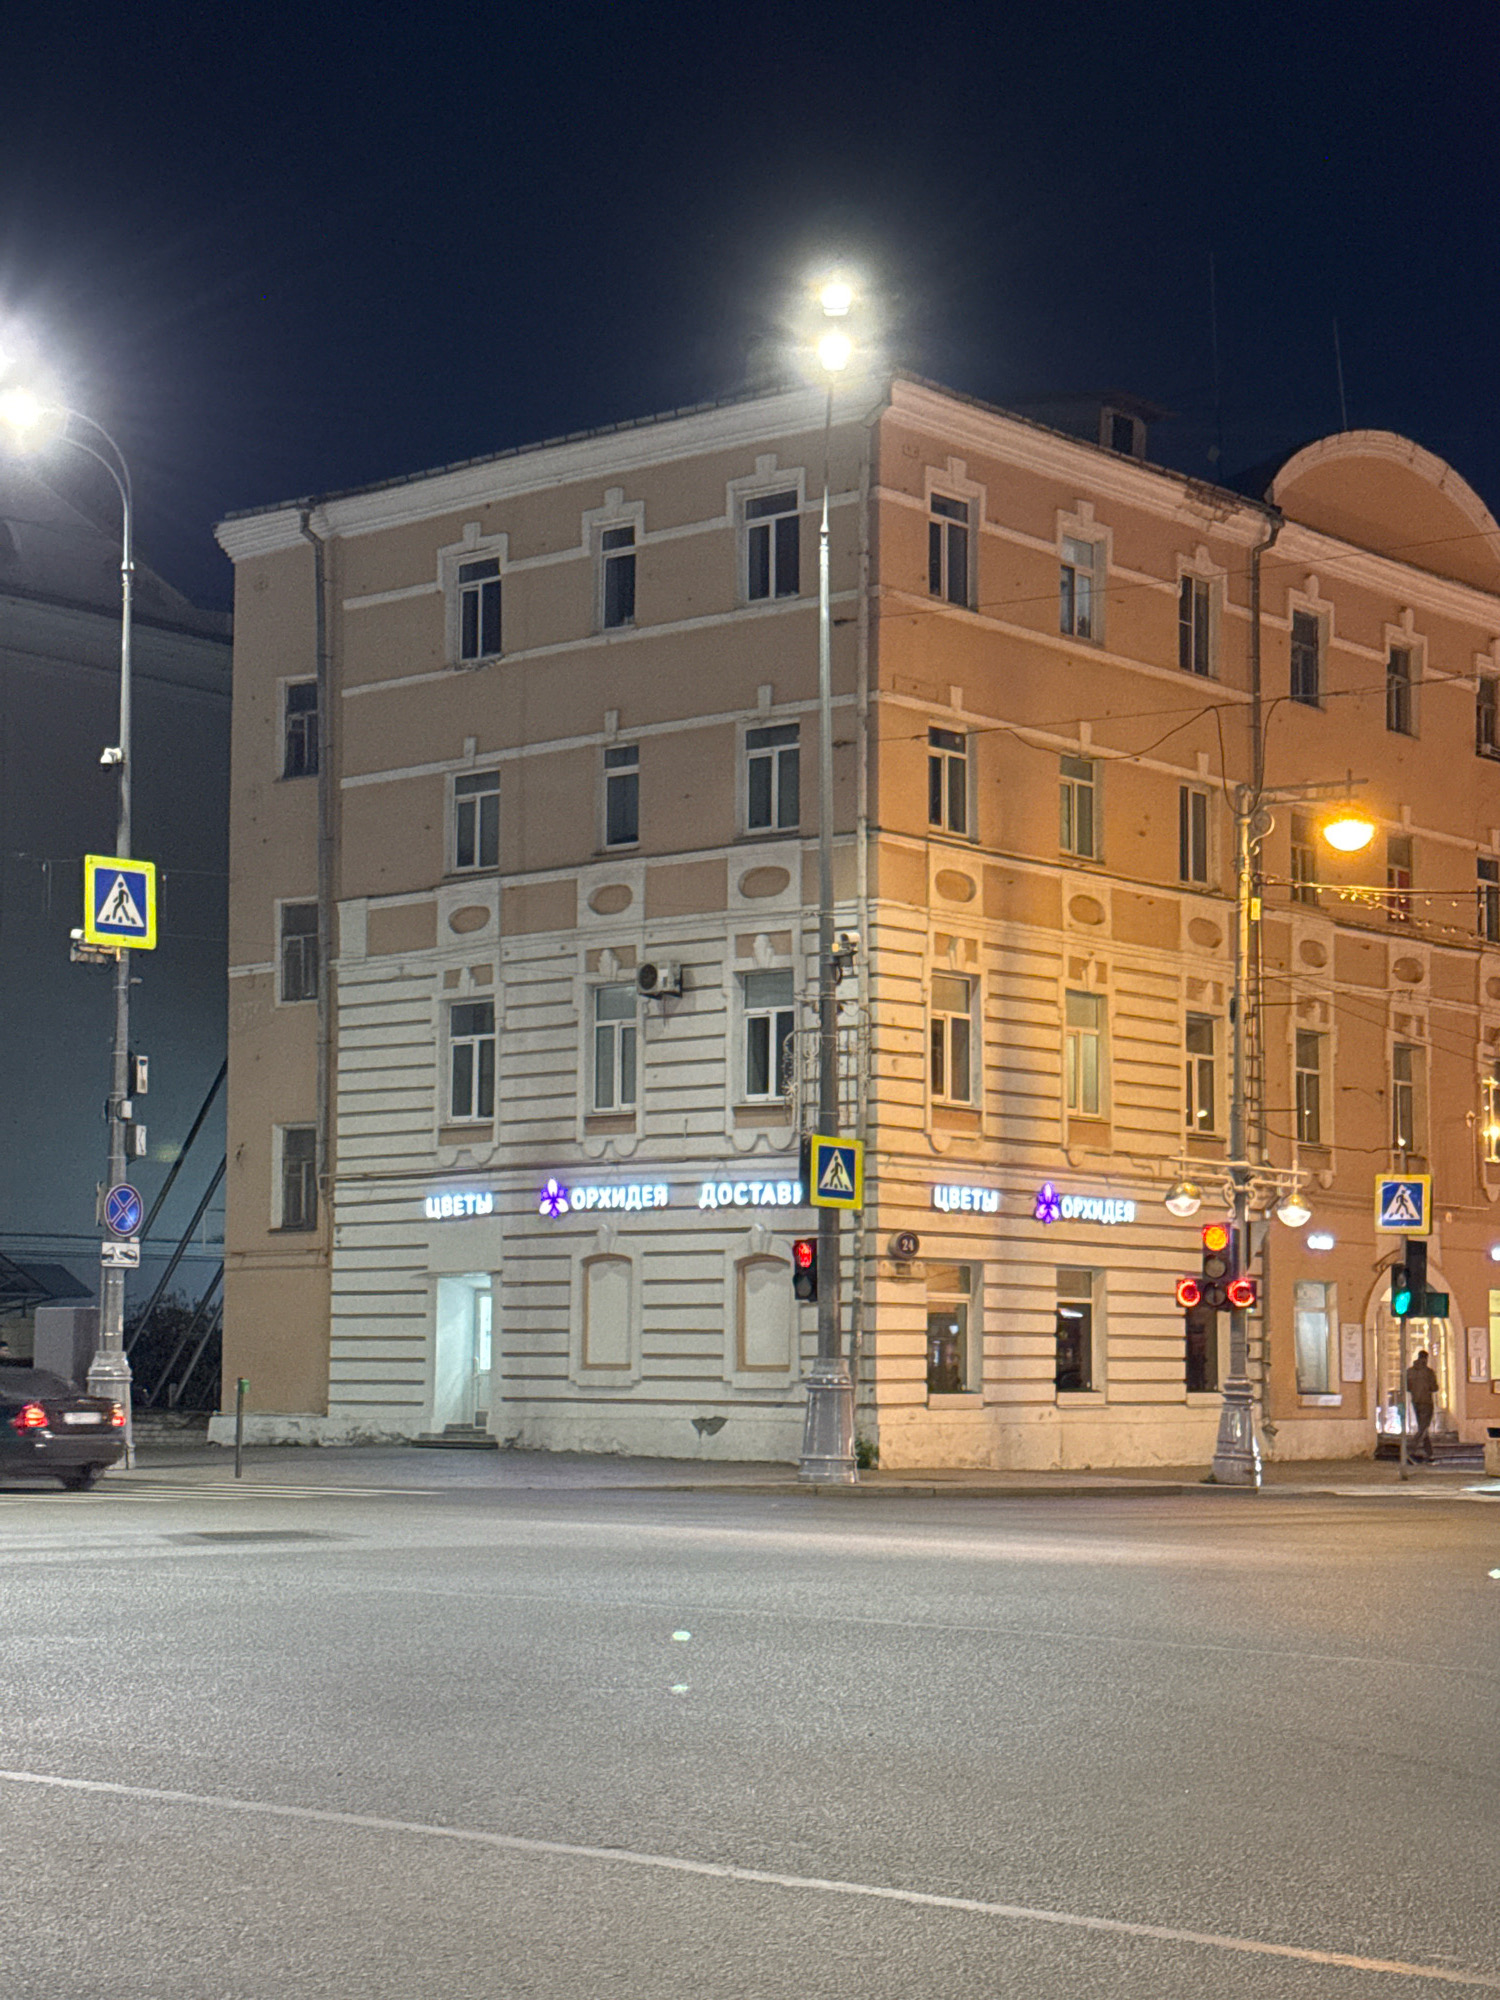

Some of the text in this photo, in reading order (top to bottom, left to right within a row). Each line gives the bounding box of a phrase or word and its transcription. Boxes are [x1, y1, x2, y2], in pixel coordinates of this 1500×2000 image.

[425, 1192, 494, 1220] ЦВЕТЫ
[570, 1183, 669, 1211] ОРХИДЕЯ
[933, 1185, 999, 1213] ЦВЕТЫ
[1061, 1195, 1136, 1225] ОРХИДЕЯ
